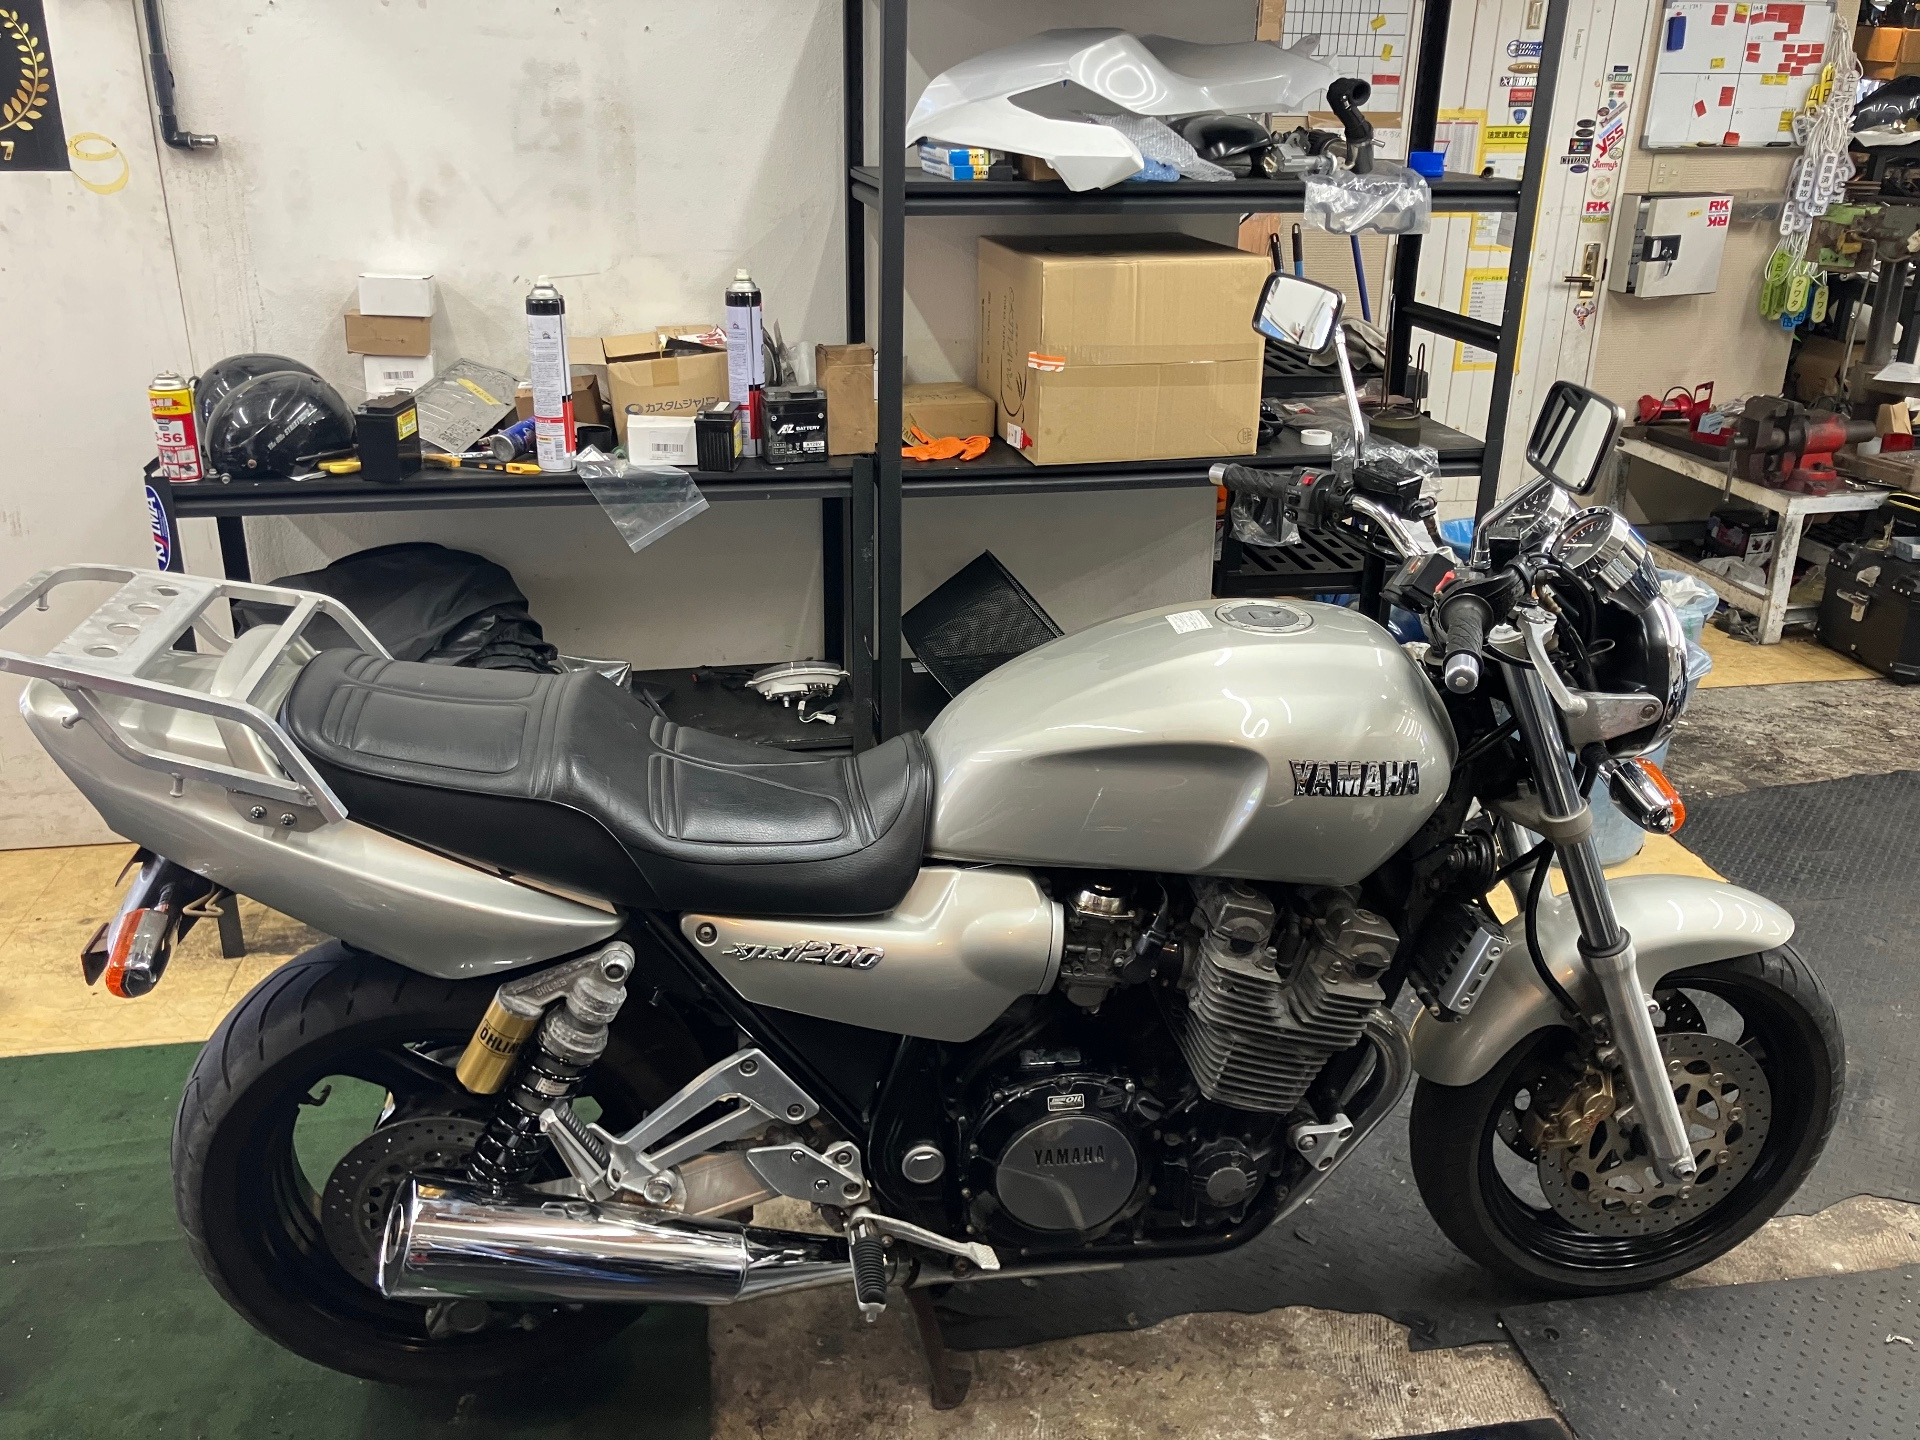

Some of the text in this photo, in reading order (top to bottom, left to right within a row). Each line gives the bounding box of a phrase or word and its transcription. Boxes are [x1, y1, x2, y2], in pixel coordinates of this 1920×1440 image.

[1595, 123, 1624, 158] YSS
[1592, 159, 1618, 171] Jimmy's
[1586, 201, 1610, 211] RK
[1709, 200, 1730, 210] RK
[1791, 280, 1804, 308] タワタ
[1289, 759, 1420, 797] YAMAHA
[722, 940, 885, 970] XJR1200
[1066, 1095, 1082, 1103] OIL
[1034, 1145, 1106, 1168] YAMAHA
